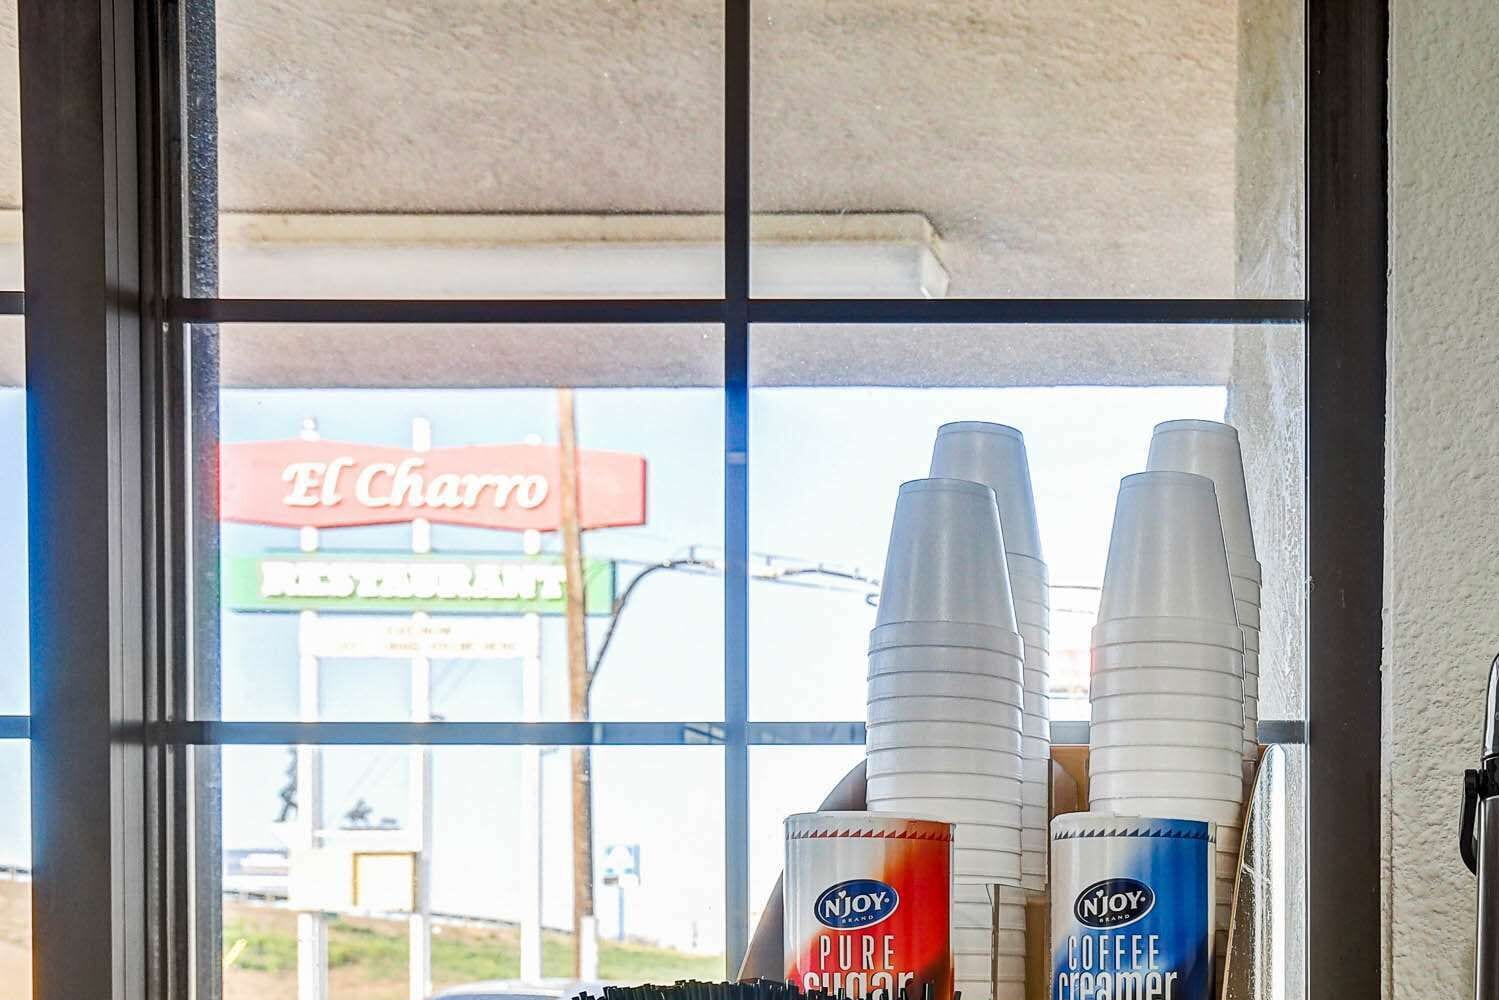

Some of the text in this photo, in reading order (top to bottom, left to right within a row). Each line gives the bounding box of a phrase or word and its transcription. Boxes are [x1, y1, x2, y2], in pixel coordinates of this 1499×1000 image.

[282, 457, 549, 509] El Charro
[819, 934, 895, 971] PURE
[1067, 934, 1160, 972] COFFEE
